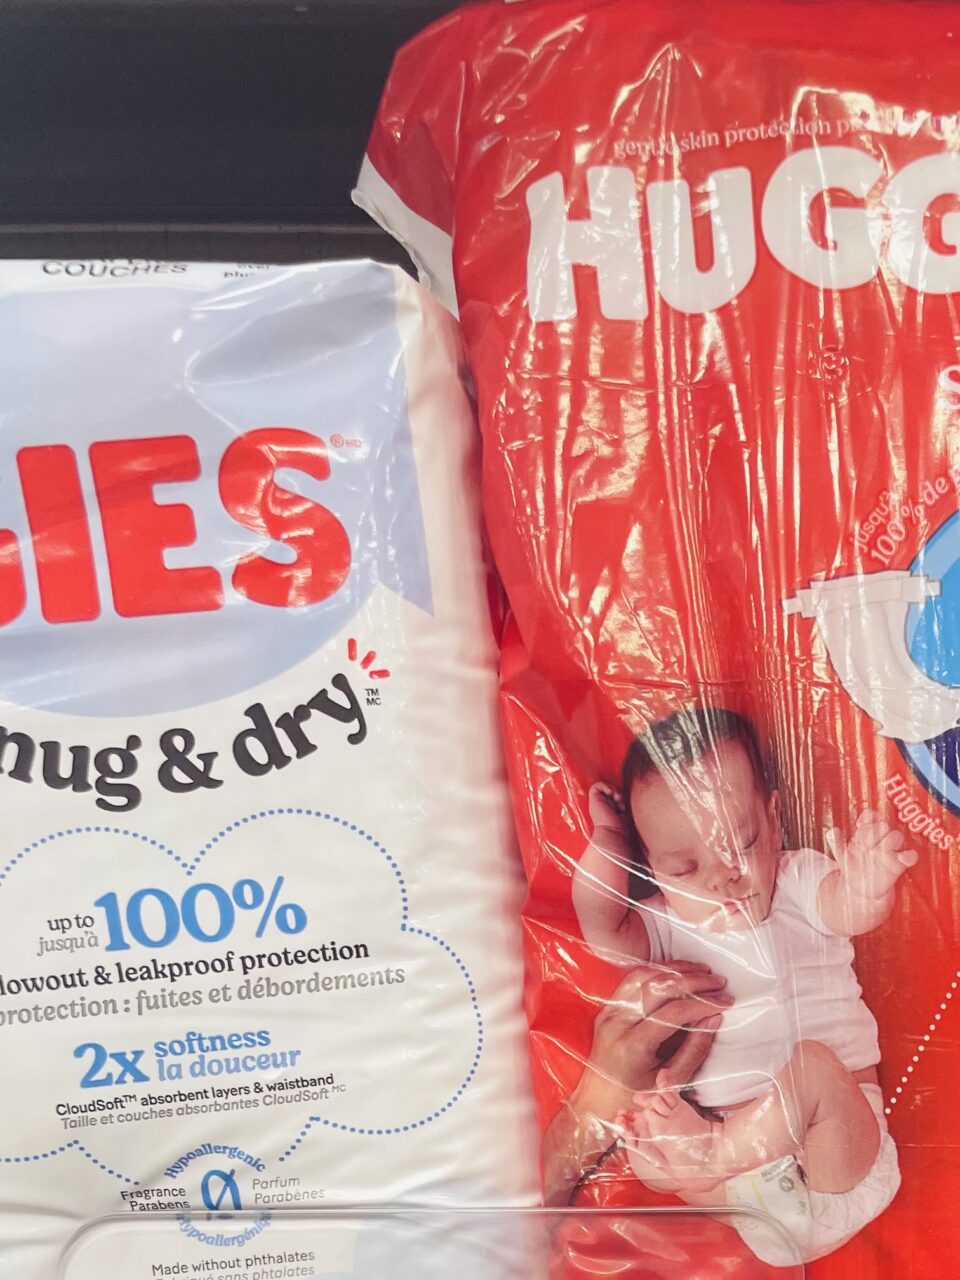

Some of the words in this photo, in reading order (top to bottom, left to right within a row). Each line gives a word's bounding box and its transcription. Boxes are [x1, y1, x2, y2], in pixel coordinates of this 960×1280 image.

[680, 127, 720, 152] skin
[920, 475, 950, 507] de
[0, 427, 352, 628] IES
[232, 672, 368, 777] dry
[157, 727, 223, 793] &
[47, 917, 73, 934] up
[75, 914, 95, 929] to
[94, 875, 307, 952] 100%
[37, 930, 99, 957] jusqu'à
[94, 964, 113, 987] &
[117, 950, 236, 984] leakproof
[240, 942, 370, 975] protection
[136, 988, 203, 1016] fuites
[208, 984, 233, 1004] et
[237, 966, 406, 1001] débordements
[73, 1042, 151, 1088] 2x
[153, 1029, 271, 1059] softness
[156, 1058, 184, 1082] la
[189, 1049, 302, 1078] douceur
[140, 1088, 210, 1107] absorbent
[211, 1083, 251, 1105] layers
[265, 1073, 335, 1092] waistband
[61, 1117, 98, 1130] Taille
[100, 1112, 115, 1125] et
[116, 1103, 174, 1124] couches
[176, 1098, 260, 1116] absorbantes
[164, 1143, 266, 1180] Hypoallergenic
[120, 1187, 187, 1204] Fragrance
[252, 1177, 301, 1190] Parfum
[255, 1189, 326, 1204] Parabènes
[130, 1200, 191, 1212] Parabens
[152, 1263, 189, 1277] Made
[191, 1257, 242, 1272] without
[245, 1250, 316, 1268] phthalates
